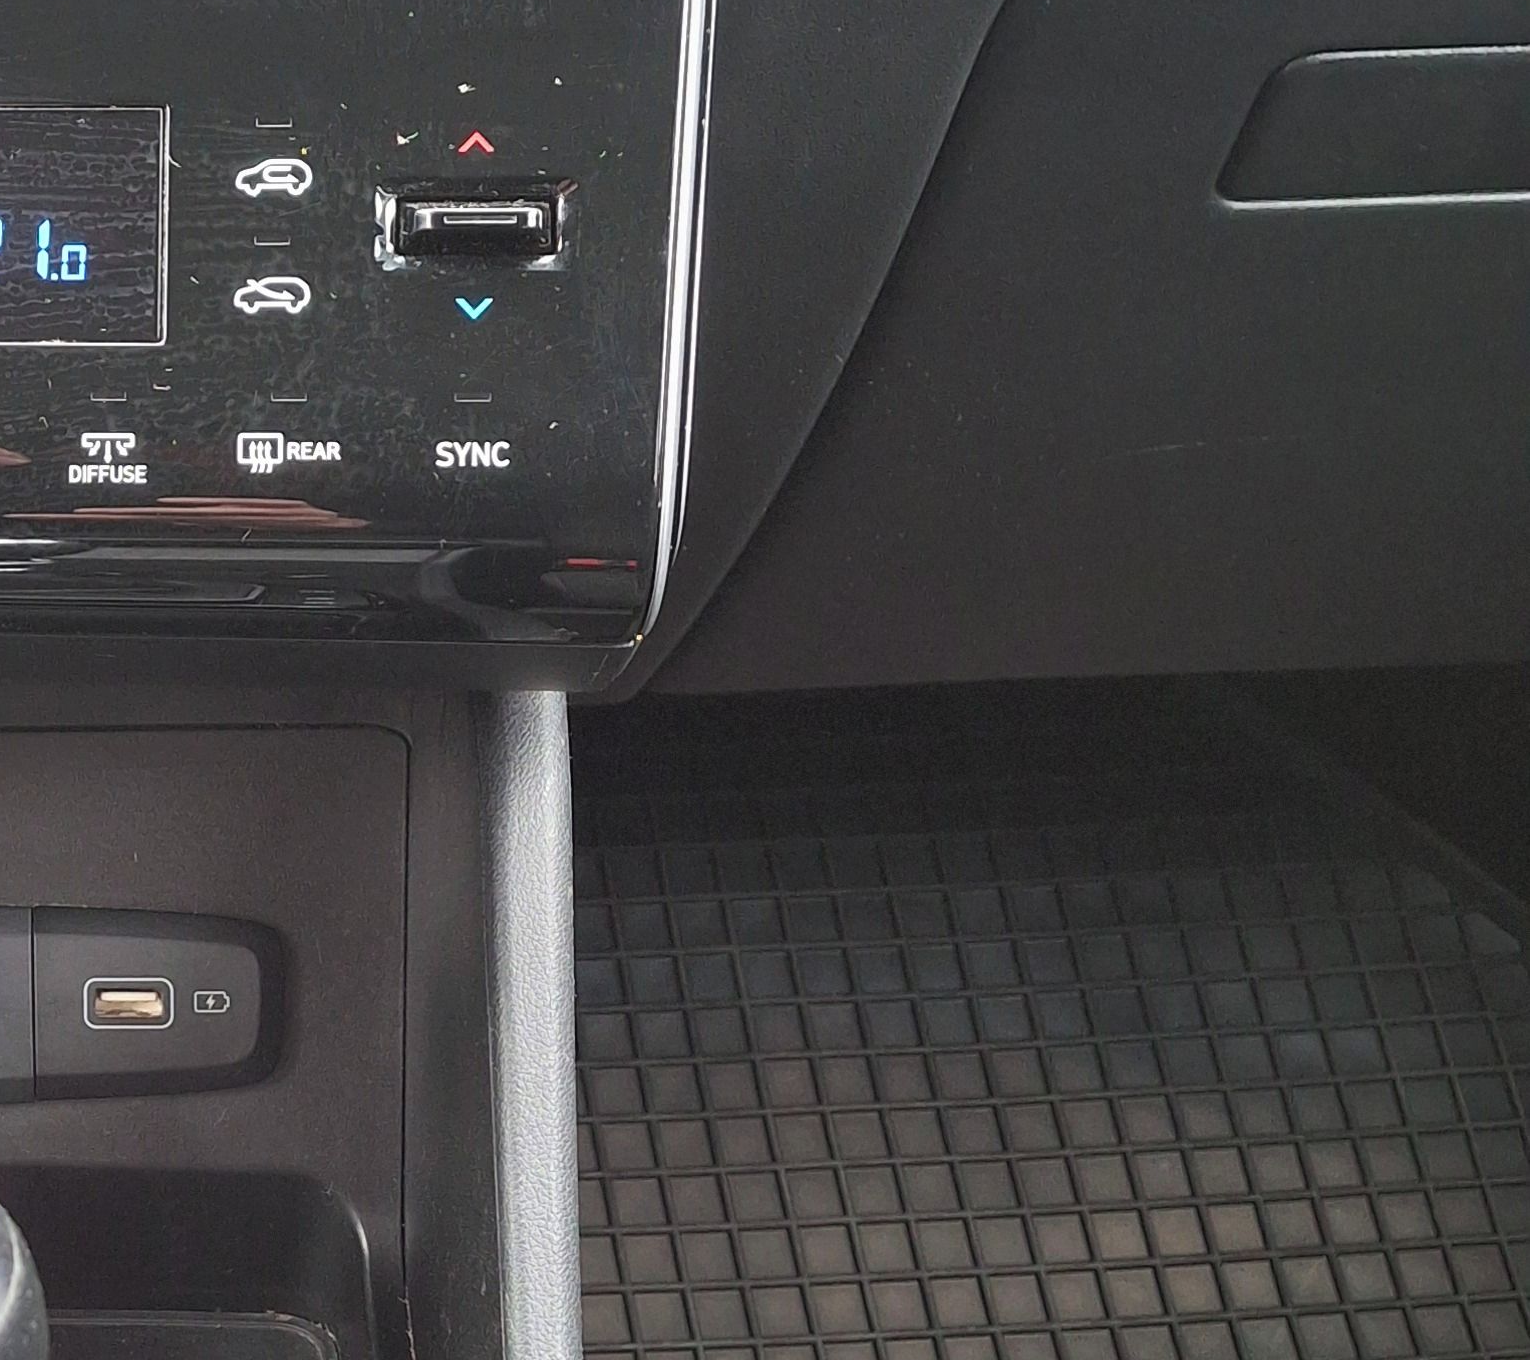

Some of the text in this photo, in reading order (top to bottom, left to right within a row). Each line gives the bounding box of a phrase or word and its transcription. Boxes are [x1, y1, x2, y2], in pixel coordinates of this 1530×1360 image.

[287, 442, 341, 461] REAR
[435, 441, 510, 467] SYNC
[68, 463, 147, 484] DIFFUSE
